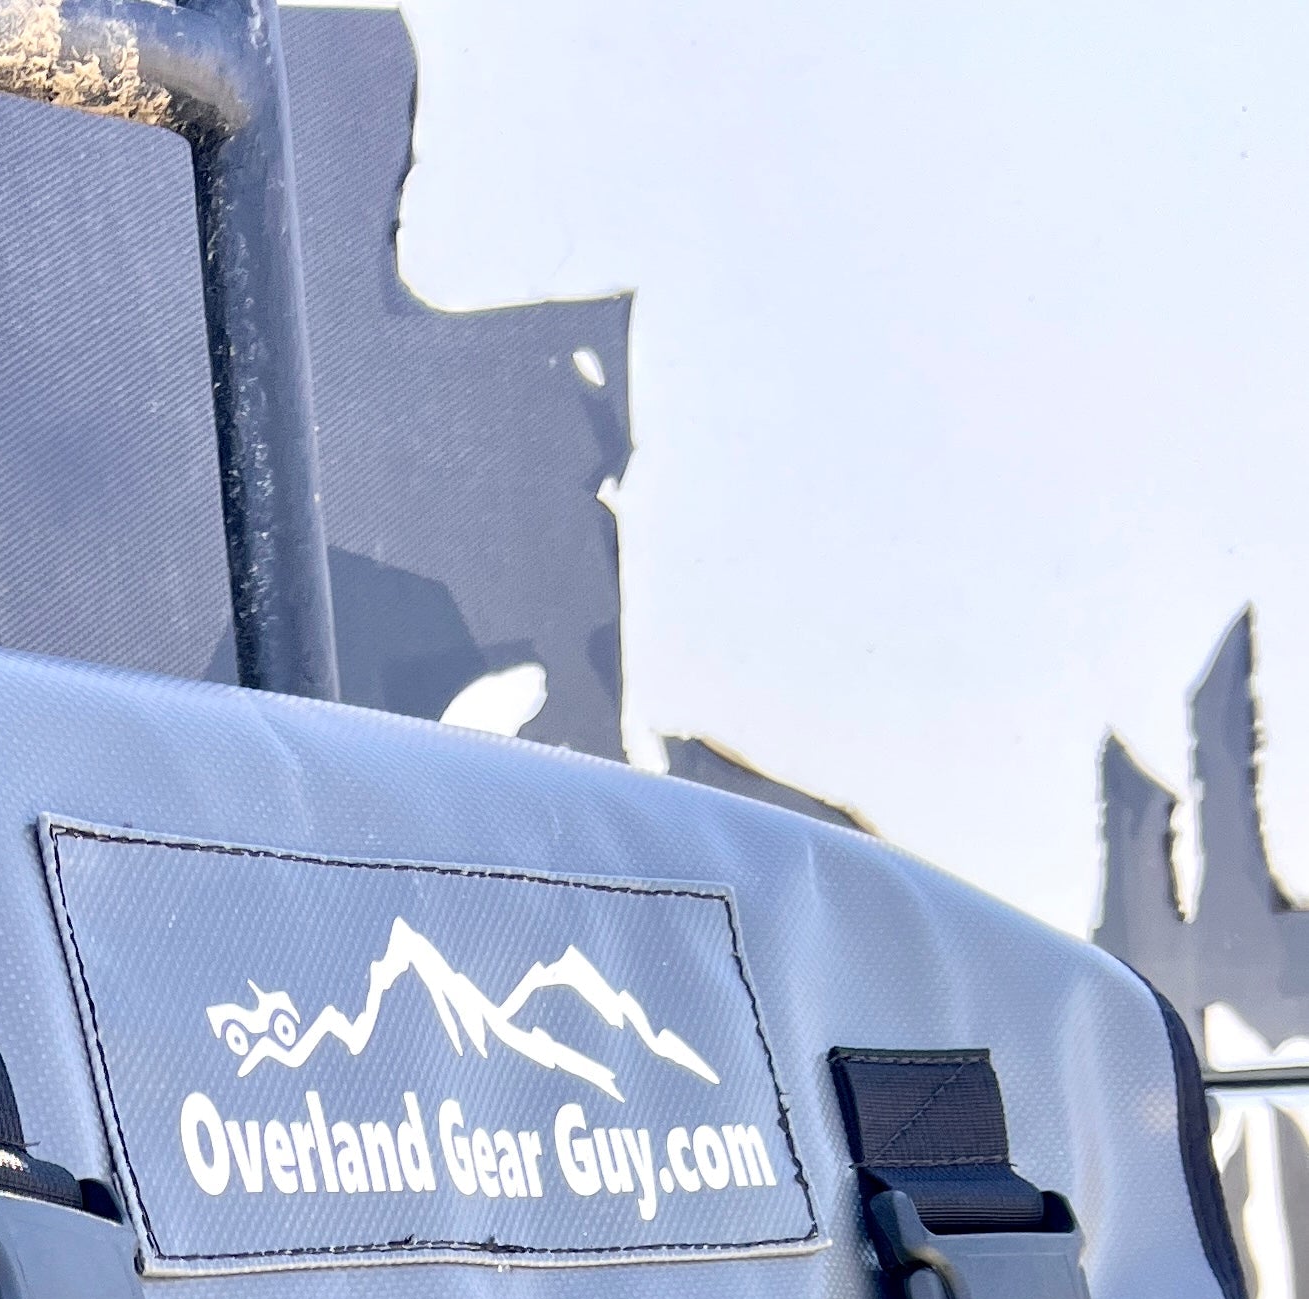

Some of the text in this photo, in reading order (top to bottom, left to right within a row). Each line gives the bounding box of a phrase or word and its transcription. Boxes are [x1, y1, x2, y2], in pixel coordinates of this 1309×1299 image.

[180, 1090, 778, 1221] Overland Gear Guy.com
